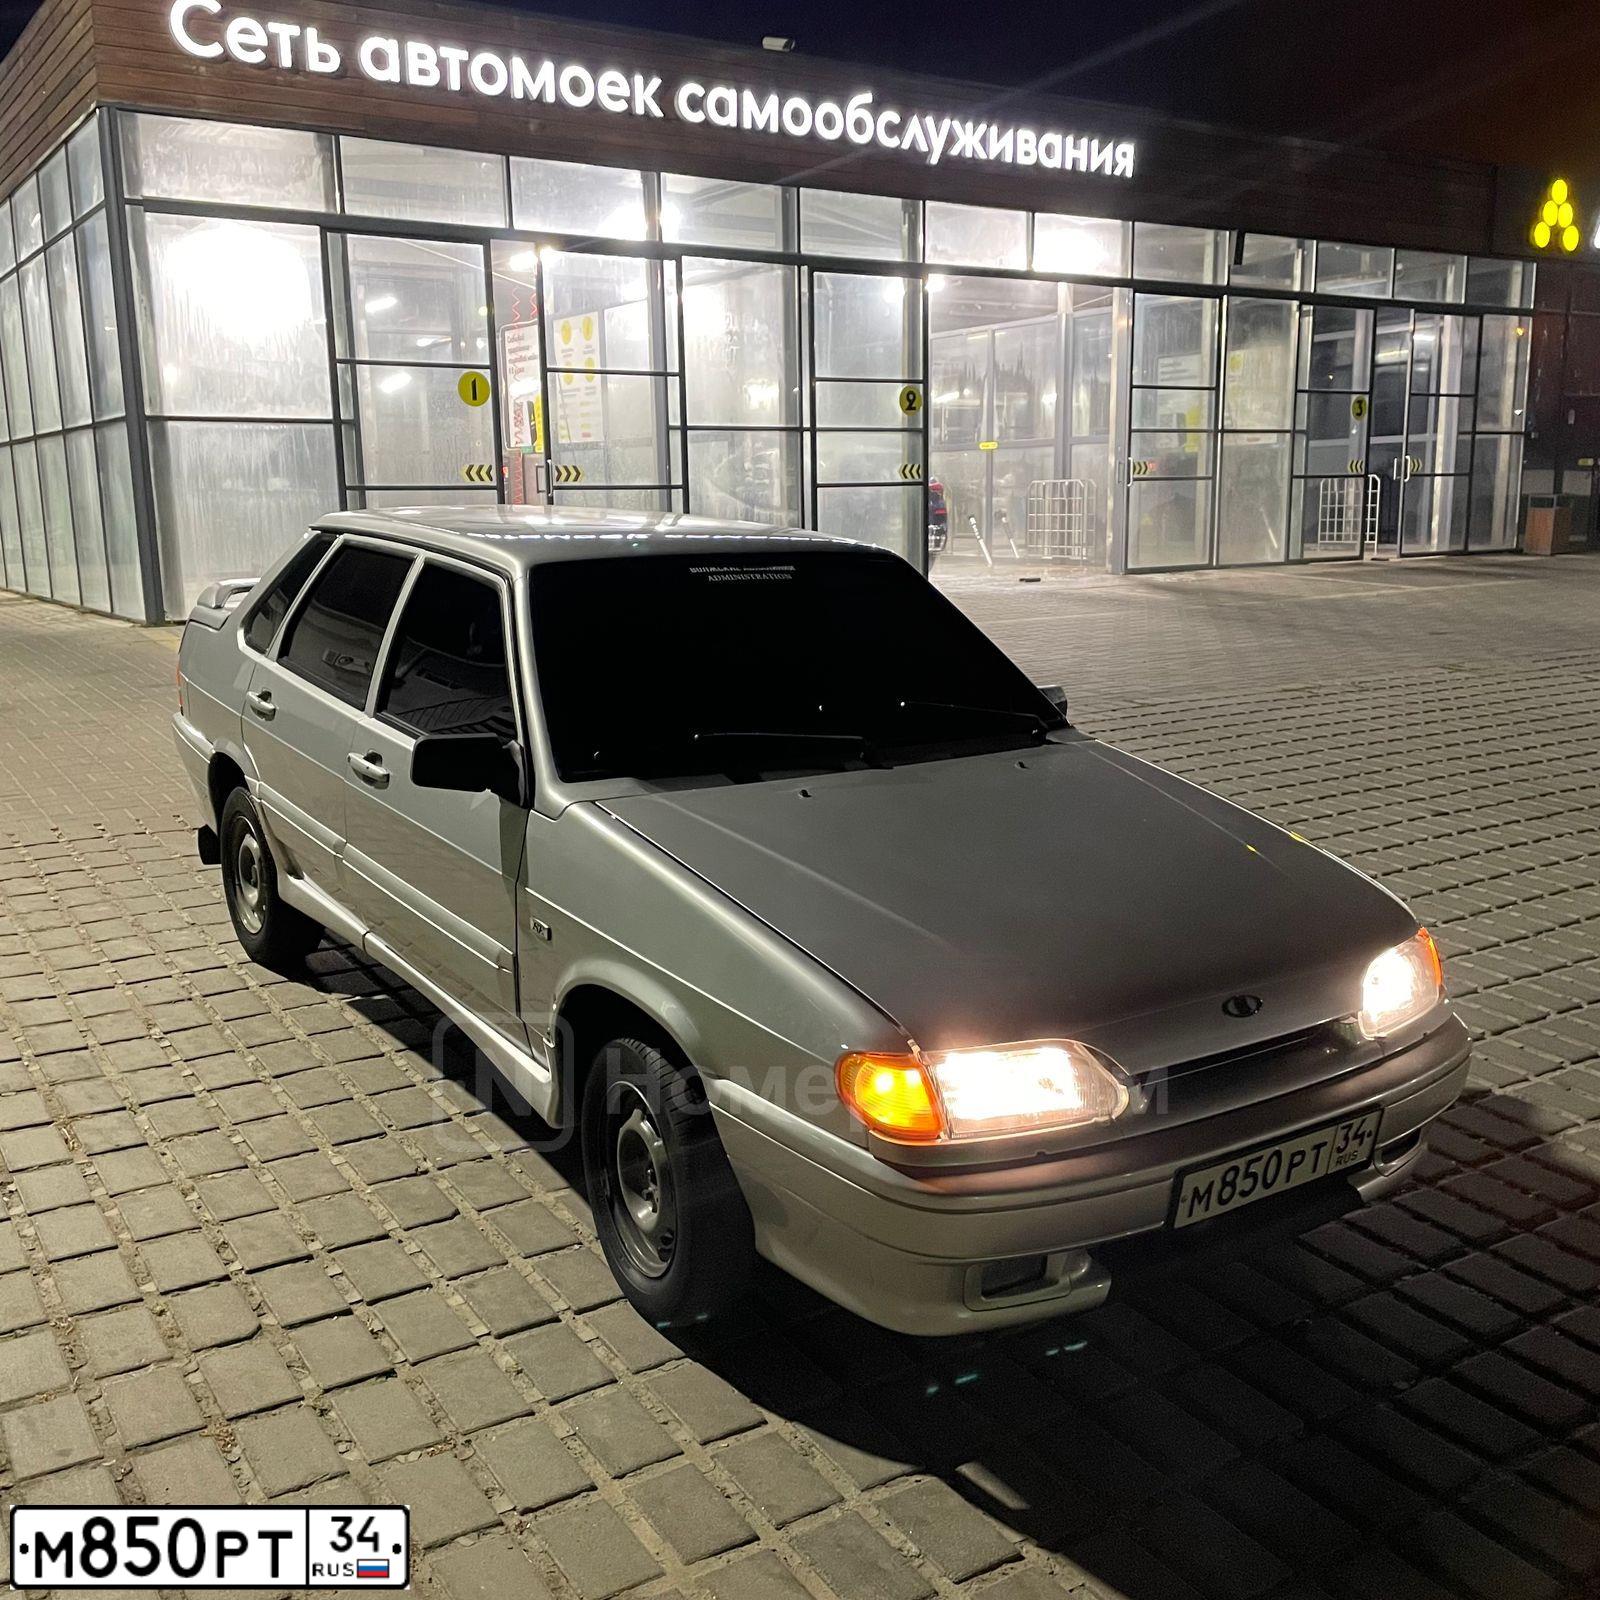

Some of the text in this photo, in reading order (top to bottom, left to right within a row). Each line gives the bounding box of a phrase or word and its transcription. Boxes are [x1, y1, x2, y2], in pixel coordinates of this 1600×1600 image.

[169, 0, 1136, 178] Сеть автомоек самообслуживания
[471, 377, 478, 401] 1
[905, 390, 917, 411] 2
[1355, 399, 1363, 417] 3
[707, 572, 793, 582] ADMINISTRATION
[1335, 1116, 1367, 1154] 34
[1335, 1151, 1359, 1167] RUS
